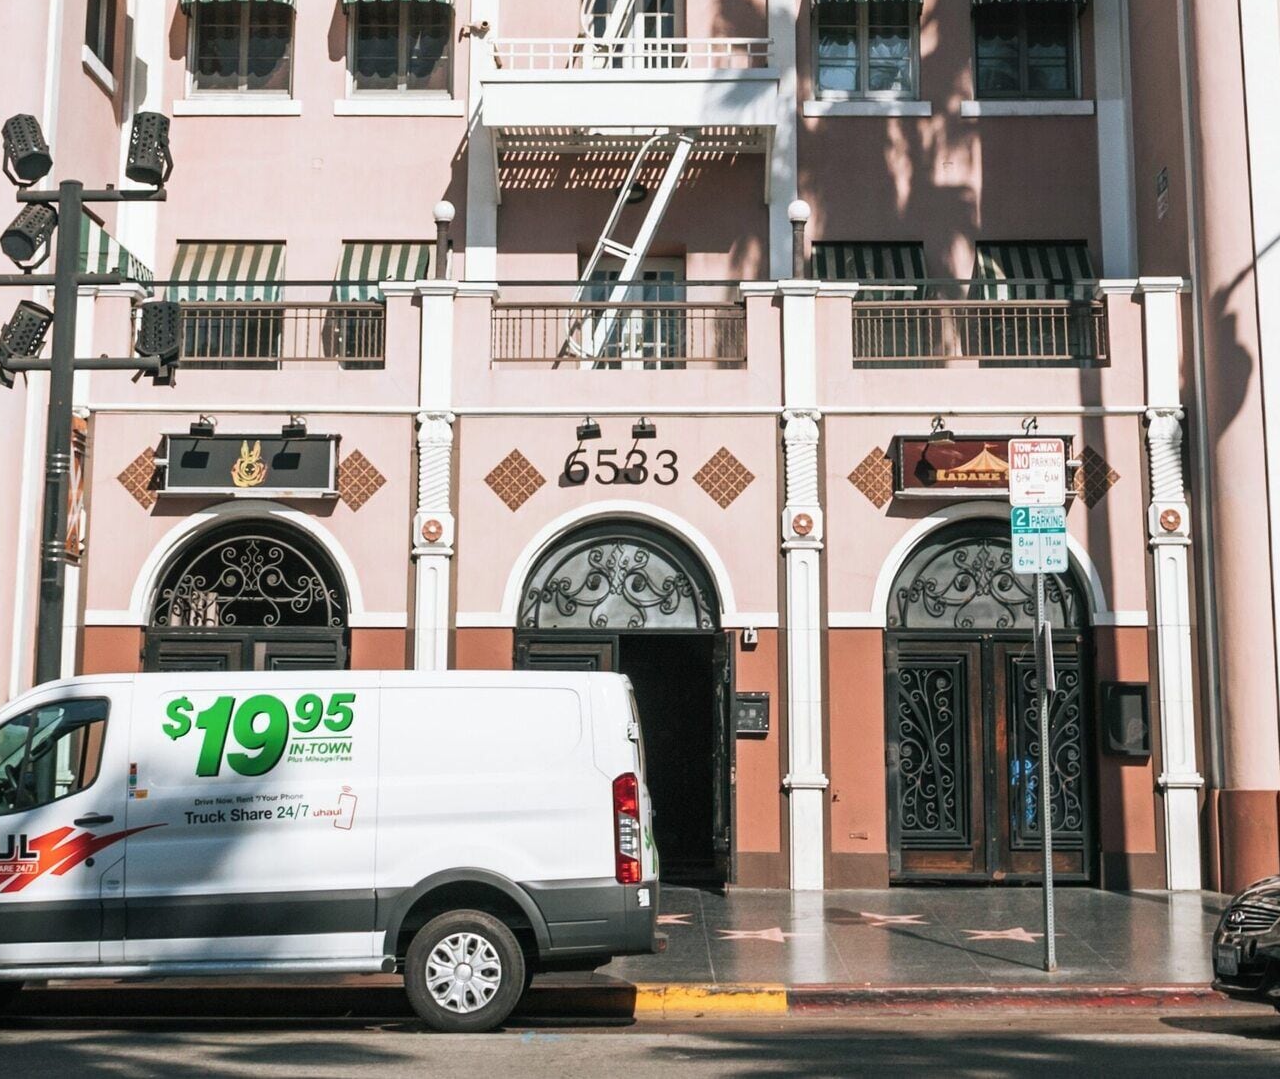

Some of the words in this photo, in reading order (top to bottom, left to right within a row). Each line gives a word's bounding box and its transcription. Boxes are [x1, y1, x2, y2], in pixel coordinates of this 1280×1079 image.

[564, 449, 679, 485] 6533
[1014, 453, 1029, 469] NO
[1031, 457, 1061, 468] PARKING
[1016, 509, 1026, 526] 2
[1031, 516, 1064, 527] PARKING
[289, 741, 353, 756] IN-TOWN
[287, 756, 304, 764] Plus
[194, 798, 214, 807] Drive
[236, 795, 254, 804] Rent
[280, 792, 304, 801] Phone
[184, 810, 227, 825] Truck
[230, 807, 273, 822] Share
[276, 803, 310, 821] 24/7
[313, 808, 343, 817] uhaul
[15, 864, 34, 873] 24/7
